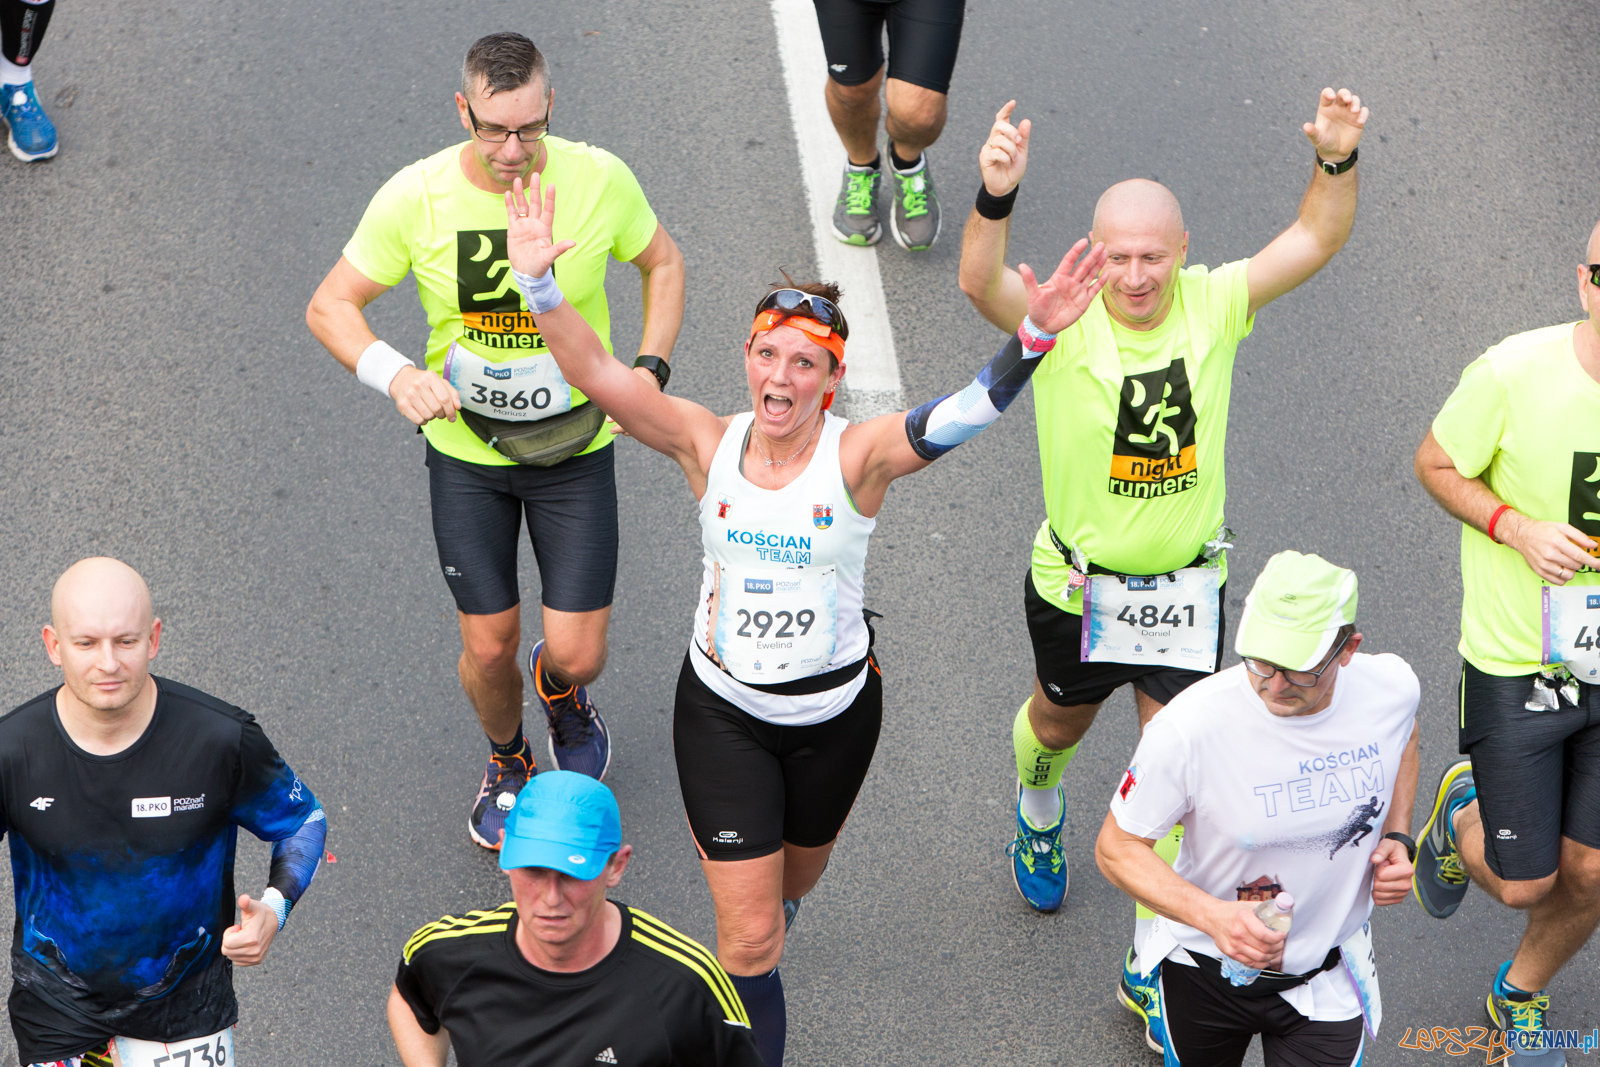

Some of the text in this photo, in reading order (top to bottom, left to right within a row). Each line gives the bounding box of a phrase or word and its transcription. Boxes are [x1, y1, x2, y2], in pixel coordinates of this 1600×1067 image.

[481, 311, 537, 332] night
[470, 383, 551, 410] 3860
[493, 408, 527, 417] Mariusz
[1131, 454, 1182, 481] night
[1110, 471, 1197, 498] runners
[727, 529, 811, 550] KOŚCIAN
[756, 547, 811, 564] TEAM
[736, 608, 816, 638] 2929
[1117, 604, 1195, 628] 4841
[756, 641, 793, 650] Ewelina
[1299, 742, 1380, 774] KOŚCIAN
[1253, 760, 1385, 818] TEAM
[136, 802, 168, 812] 18. PKO
[174, 802, 205, 812] maraton
